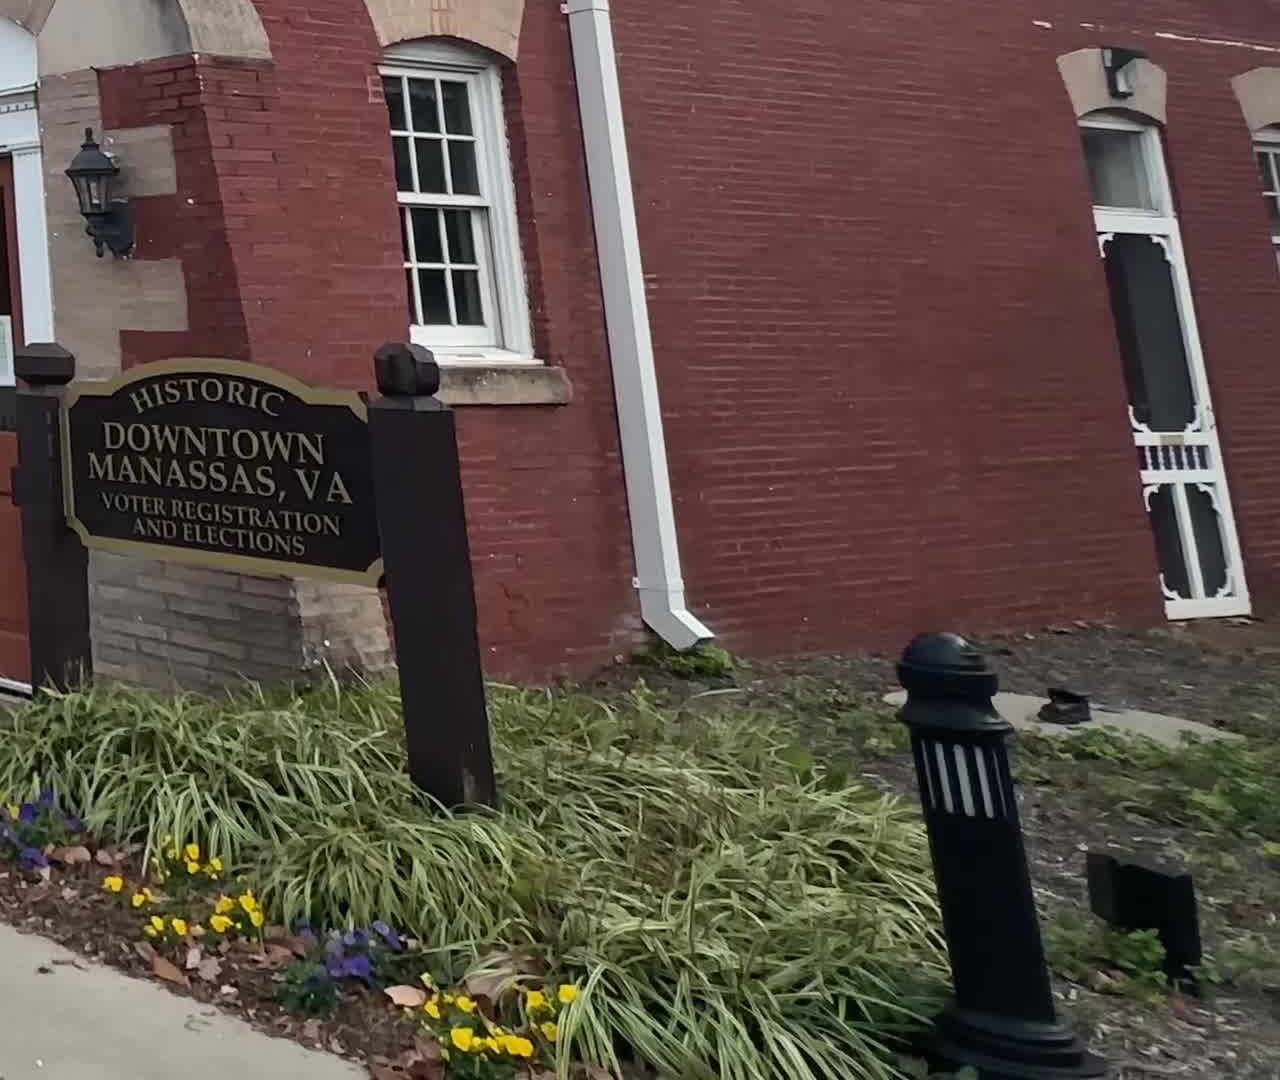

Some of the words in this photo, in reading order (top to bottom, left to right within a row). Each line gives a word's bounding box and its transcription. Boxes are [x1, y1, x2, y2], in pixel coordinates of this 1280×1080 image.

[129, 377, 286, 417] HISTORIC
[103, 421, 326, 465] DOWNTOWN
[88, 452, 288, 503] MANASSAS,
[294, 468, 354, 505] VA
[100, 490, 167, 517] VOTER
[171, 497, 341, 538] REGISTRATION
[132, 517, 178, 540] AND
[182, 522, 306, 558] ELECTIONS
